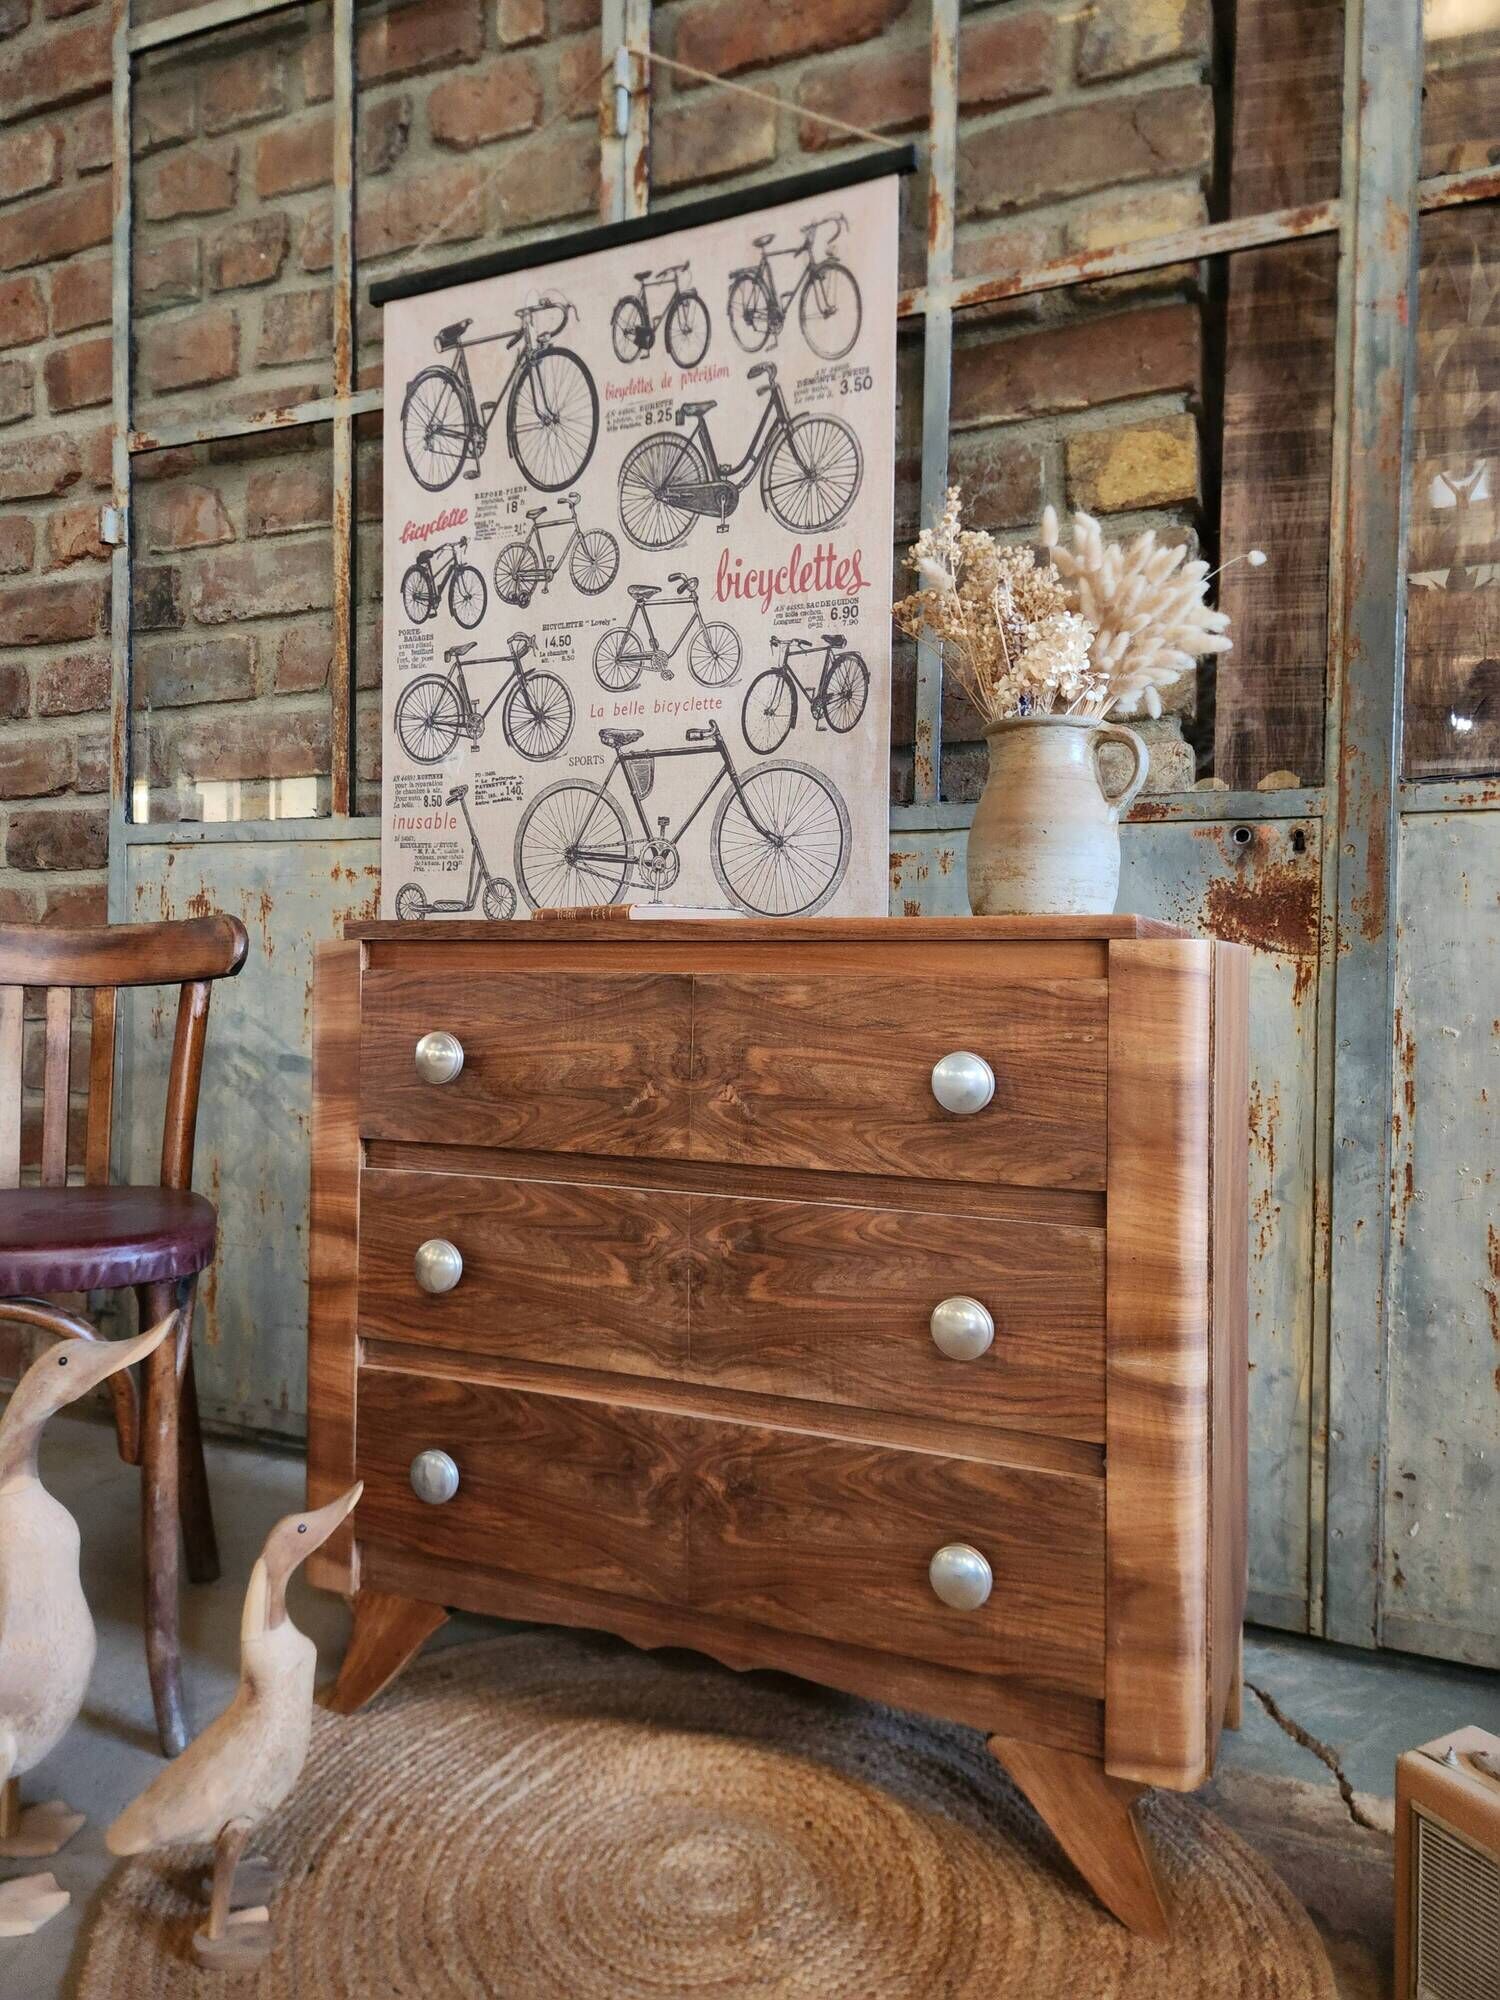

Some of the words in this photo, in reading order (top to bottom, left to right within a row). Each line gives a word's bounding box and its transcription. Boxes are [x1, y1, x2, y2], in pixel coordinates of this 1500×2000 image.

[603, 376, 654, 401] bicyclettes
[661, 371, 673, 389] de
[840, 375, 873, 395] 3.50
[645, 408, 673, 426] 8.25
[399, 508, 468, 544] bicyclette
[711, 543, 871, 614] bicyclettes
[830, 605, 859, 621] 6.90
[542, 621, 584, 631] BICYCLETTE
[545, 634, 572, 648] 14.50
[590, 704, 605, 718] La
[613, 701, 645, 717] belle
[653, 697, 723, 717] bicyclette
[568, 755, 605, 767] SPORTS
[423, 794, 443, 808] 8.50
[393, 811, 457, 831] inusable
